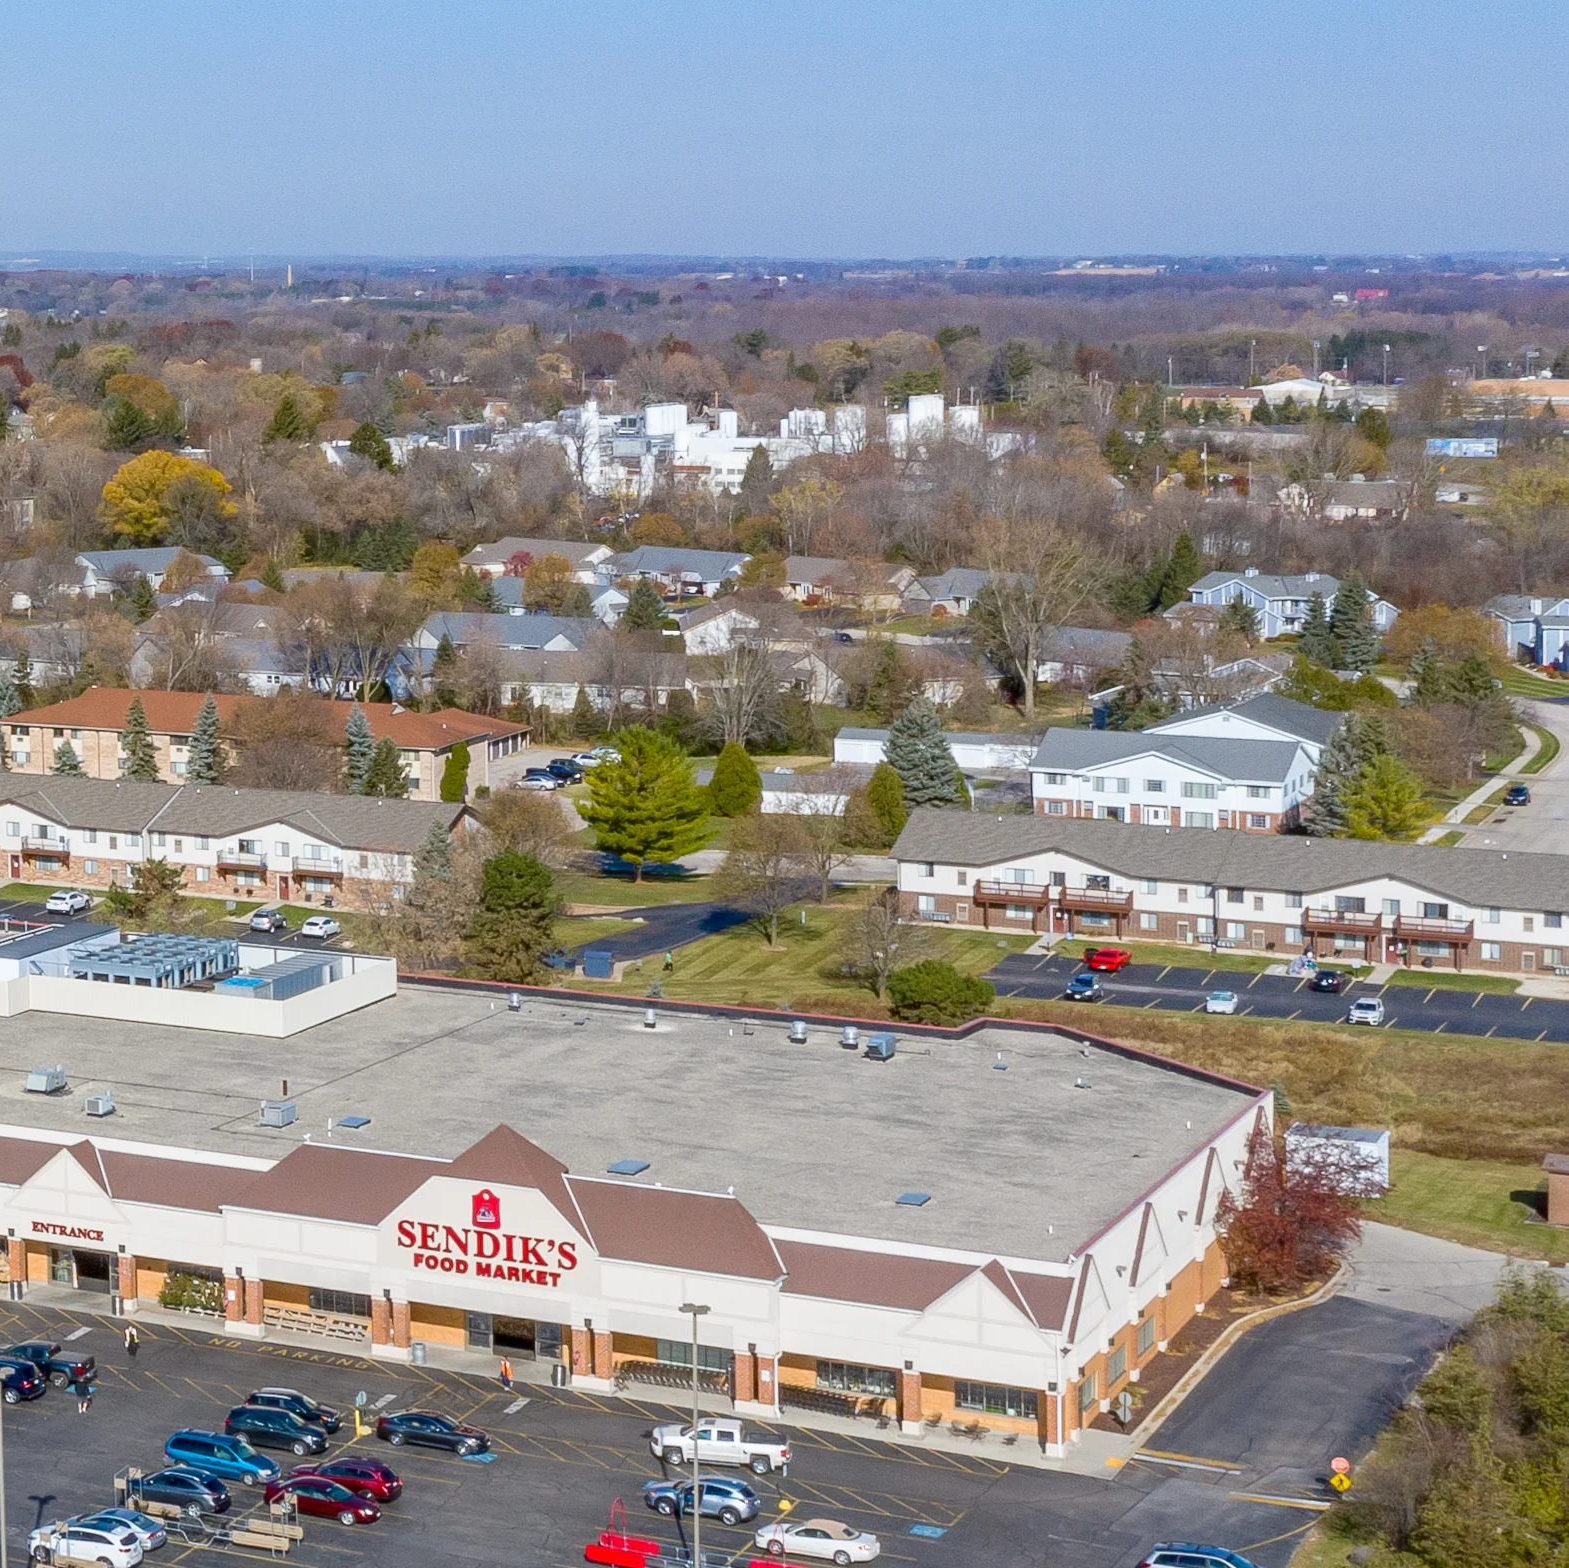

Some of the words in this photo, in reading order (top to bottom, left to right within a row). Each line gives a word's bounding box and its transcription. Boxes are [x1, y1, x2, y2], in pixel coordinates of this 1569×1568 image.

[31, 1220, 104, 1241] ENTRANCE
[397, 1219, 578, 1271] SENDIK'S
[413, 1252, 469, 1275] FOOD
[475, 1261, 561, 1288] MARKET
[208, 1337, 242, 1349] NO
[257, 1345, 370, 1370] PARKING
